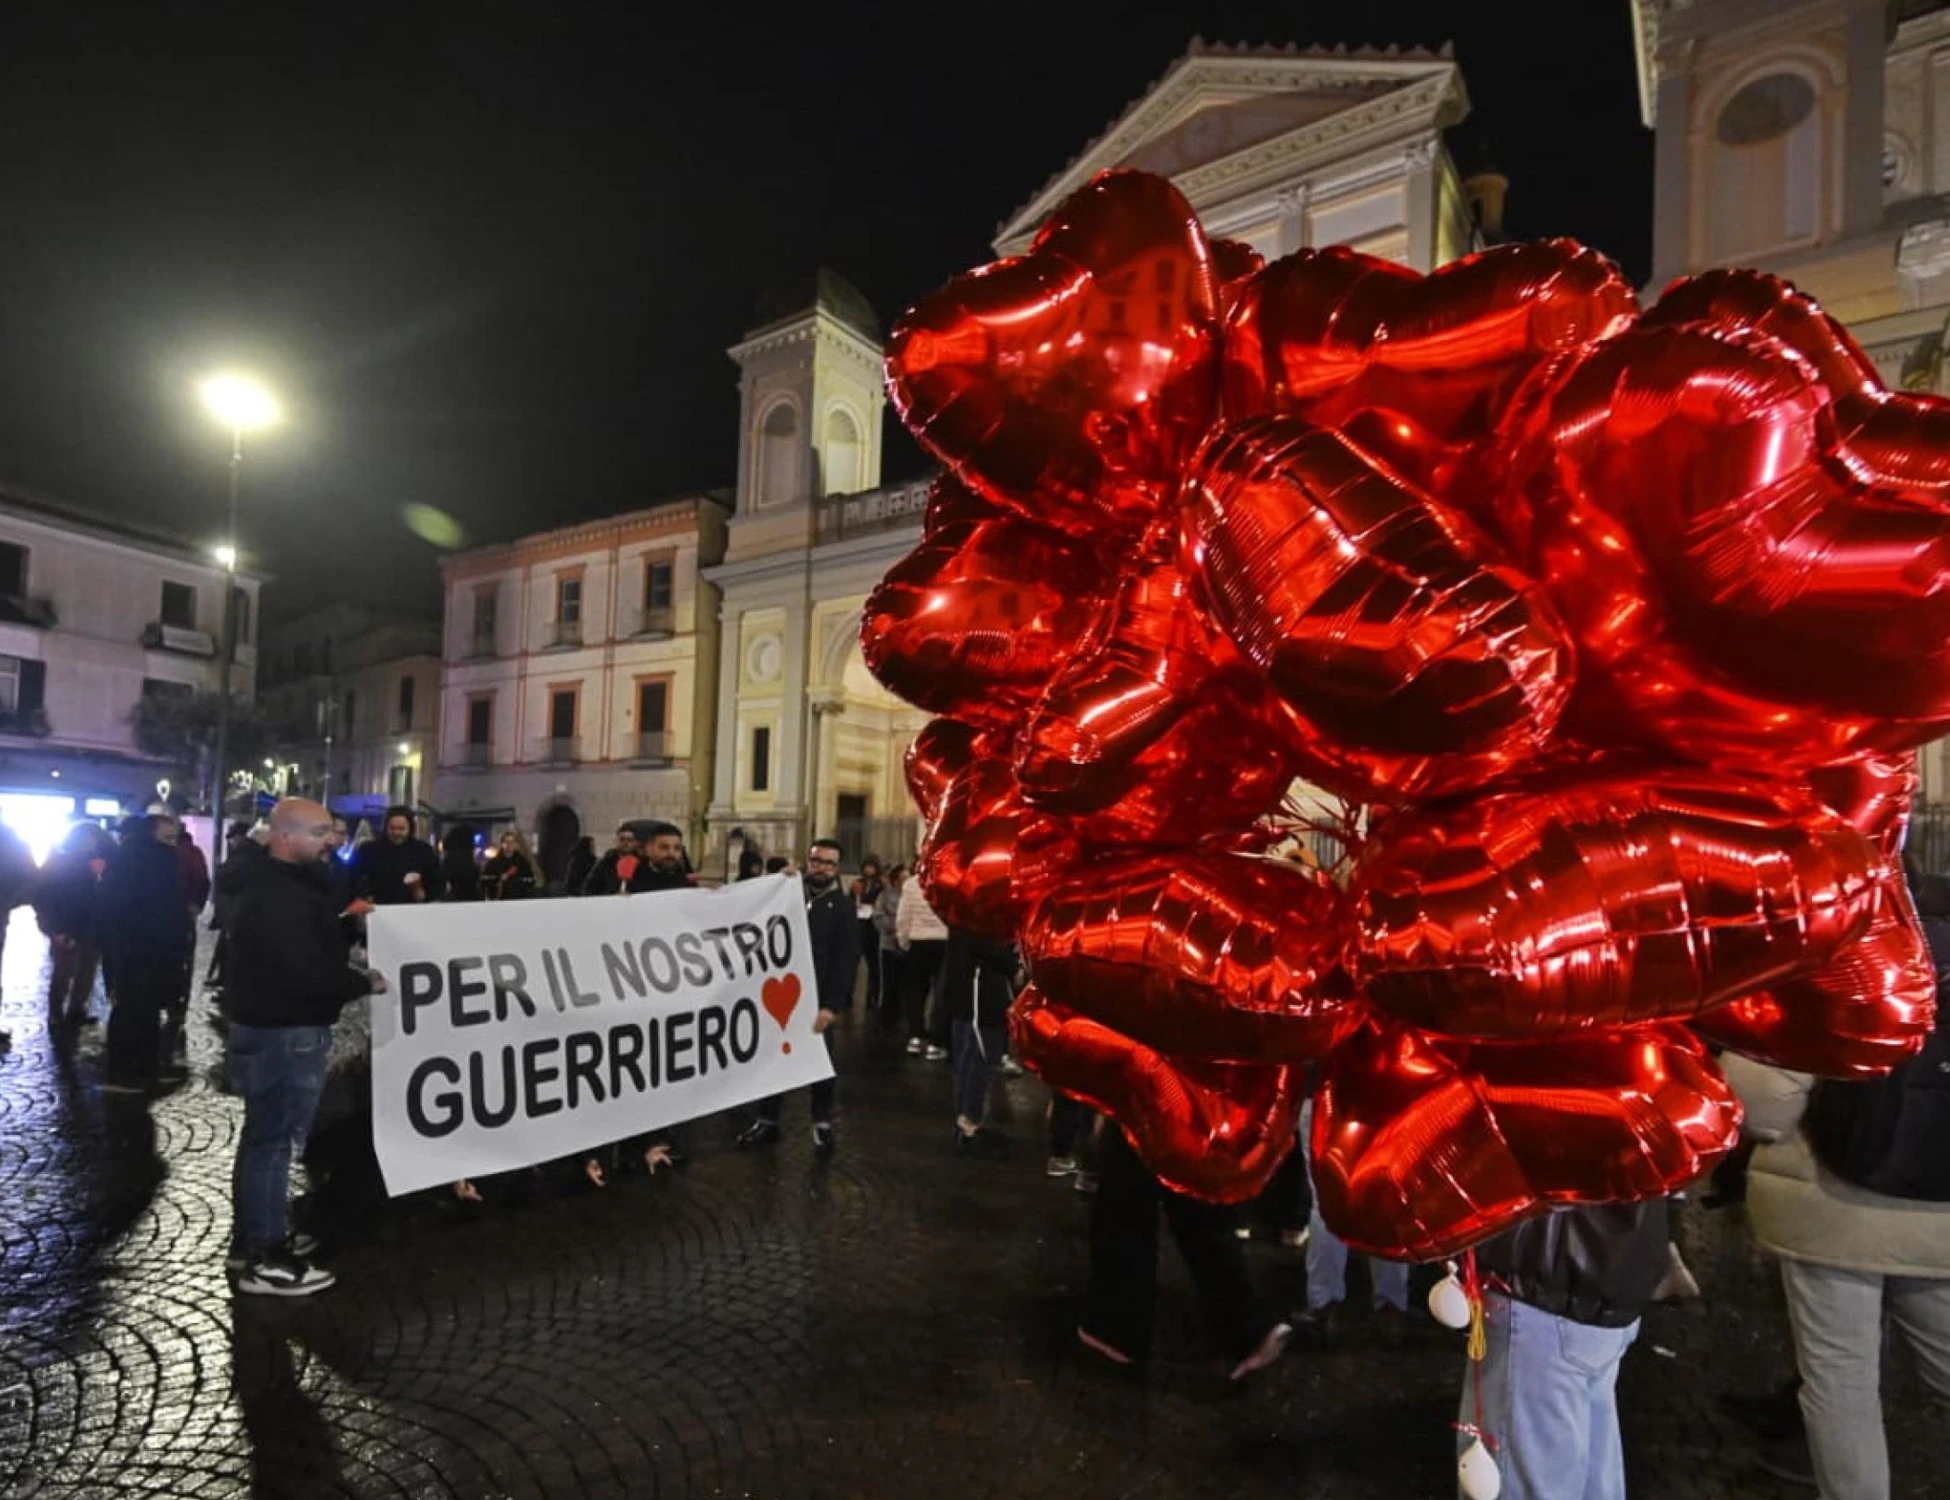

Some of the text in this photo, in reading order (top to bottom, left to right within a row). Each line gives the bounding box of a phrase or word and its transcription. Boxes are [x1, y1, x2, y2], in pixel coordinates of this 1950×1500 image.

[399, 914, 792, 1035] PER IL NOSTRO
[406, 997, 760, 1139] GUERRIERO
